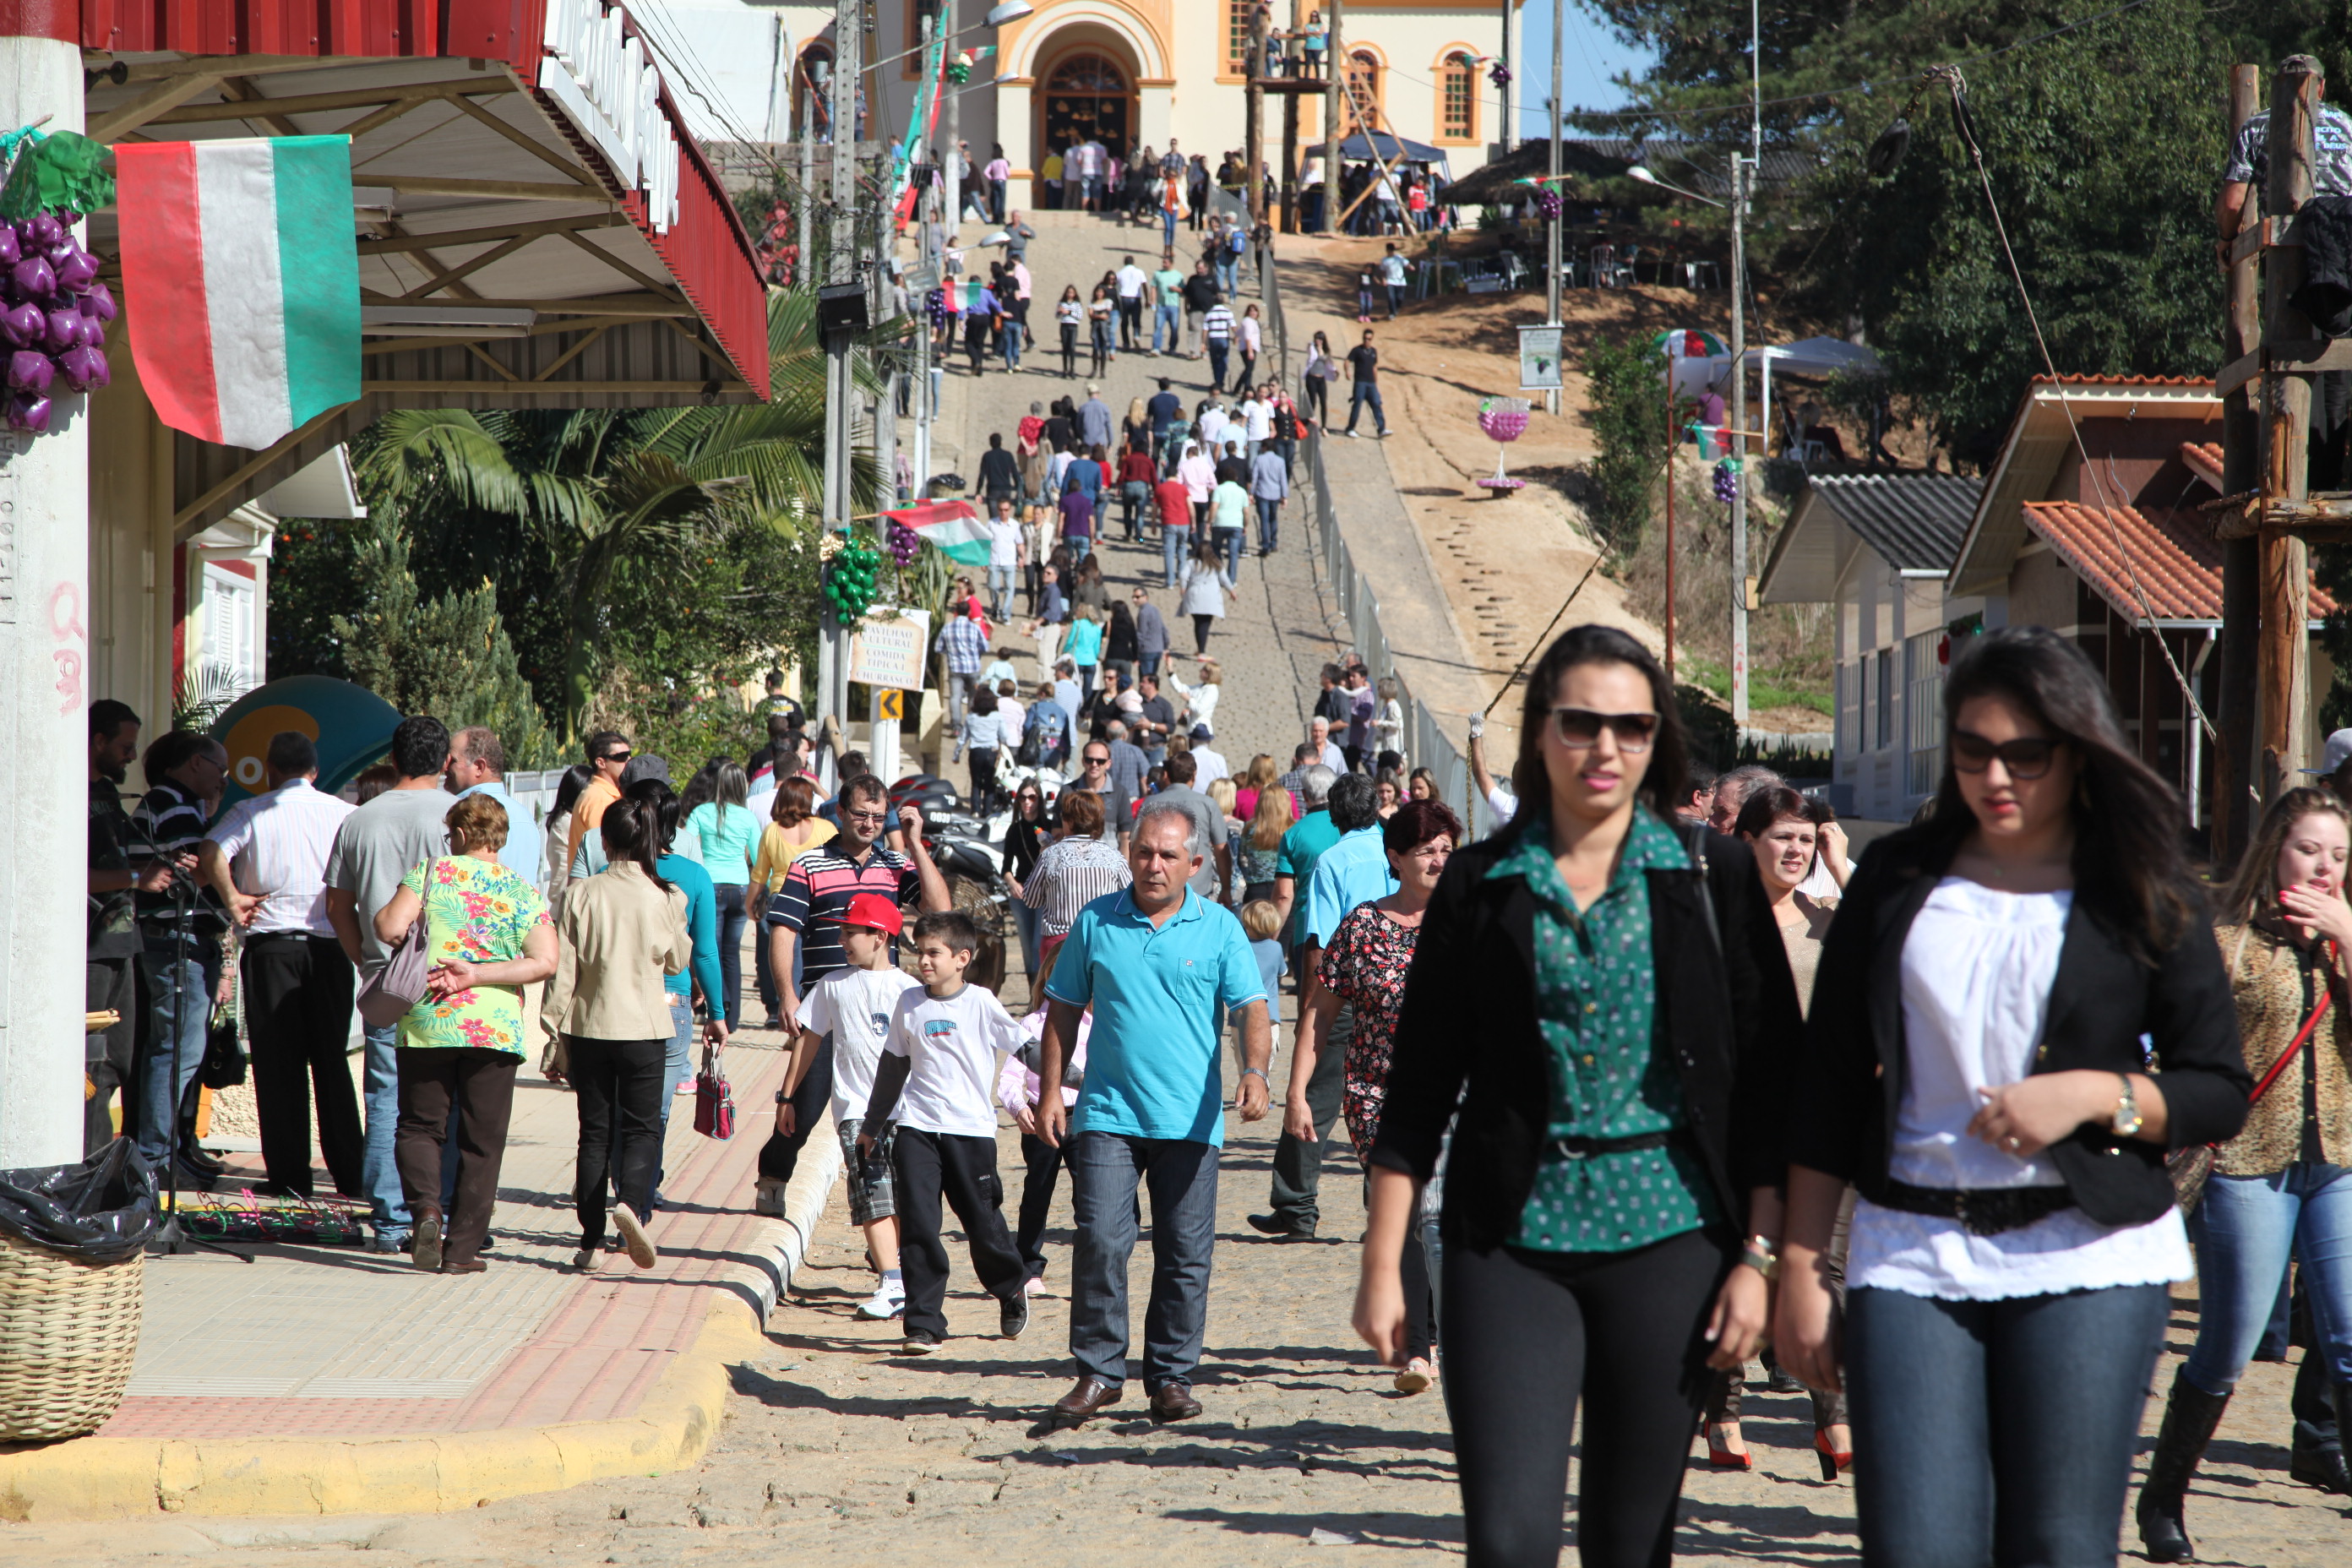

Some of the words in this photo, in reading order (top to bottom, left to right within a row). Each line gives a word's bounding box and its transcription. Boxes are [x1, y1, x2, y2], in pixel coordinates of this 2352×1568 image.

[863, 635, 911, 648] CULTURAL
[867, 649, 905, 661] COMIDA
[856, 671, 912, 684] CHURRASCO
[924, 1020, 957, 1030] ORIGINAL
[925, 1026, 949, 1037] BOARD
